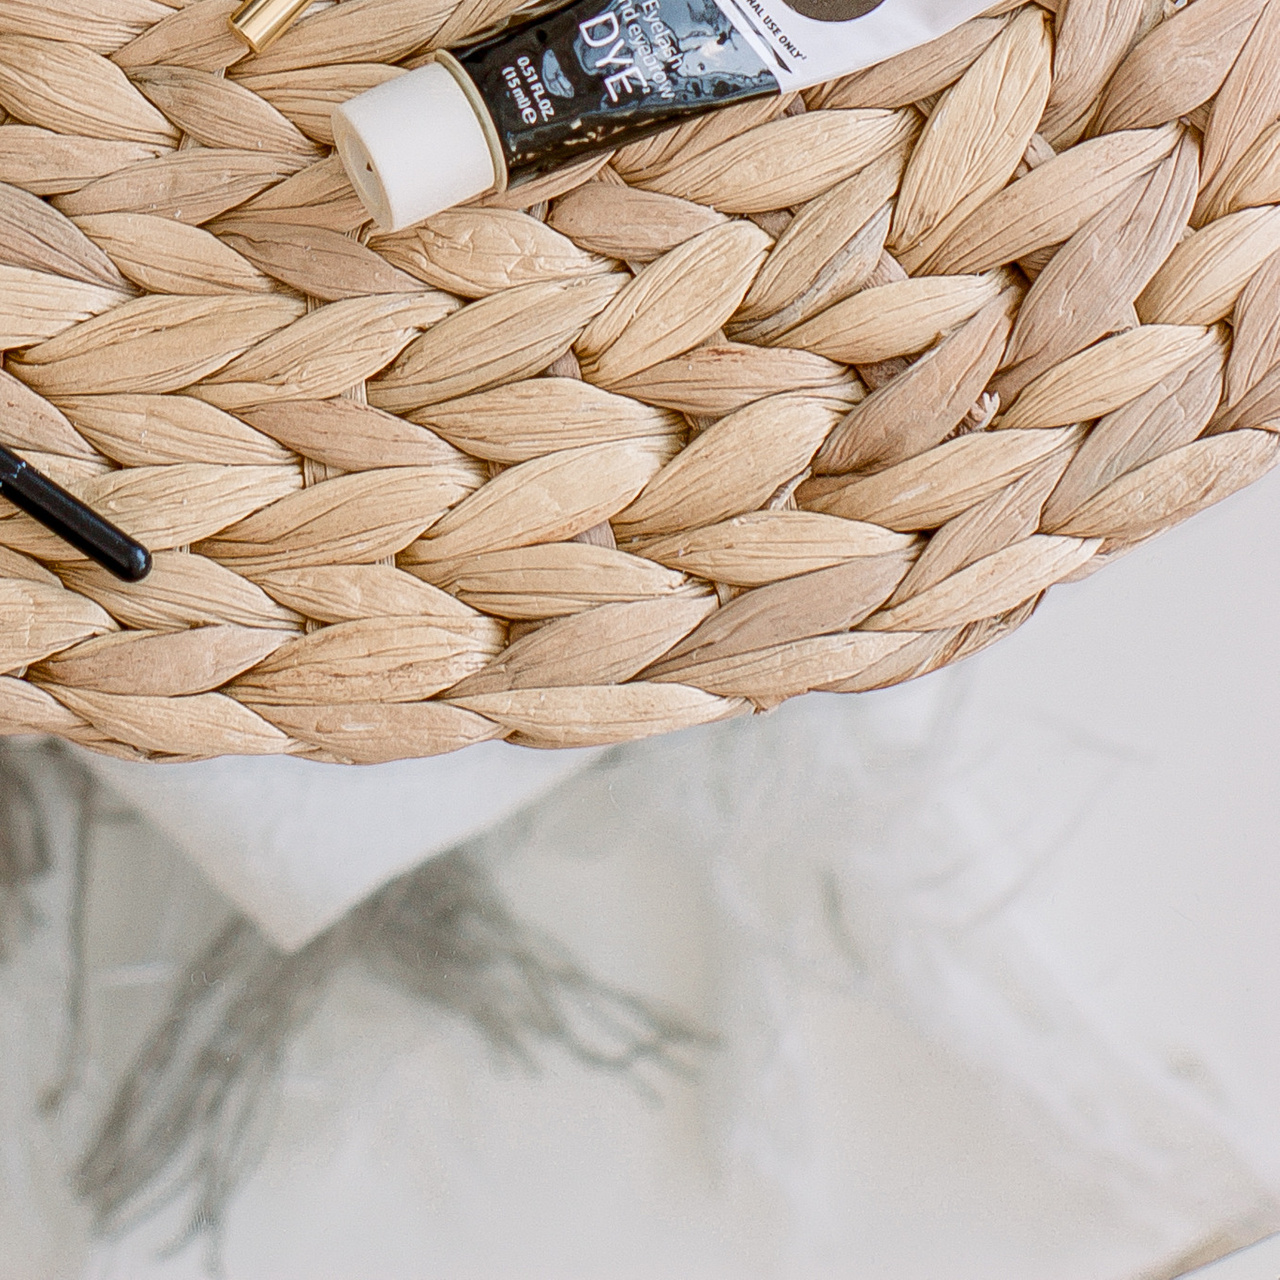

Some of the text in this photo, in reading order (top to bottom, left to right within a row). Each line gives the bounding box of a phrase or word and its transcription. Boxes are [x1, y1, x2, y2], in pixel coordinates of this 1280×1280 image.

[763, 13, 781, 37] USE
[517, 56, 537, 87] 0.51
[628, 20, 675, 100] eyebrow
[502, 66, 519, 92] (15
